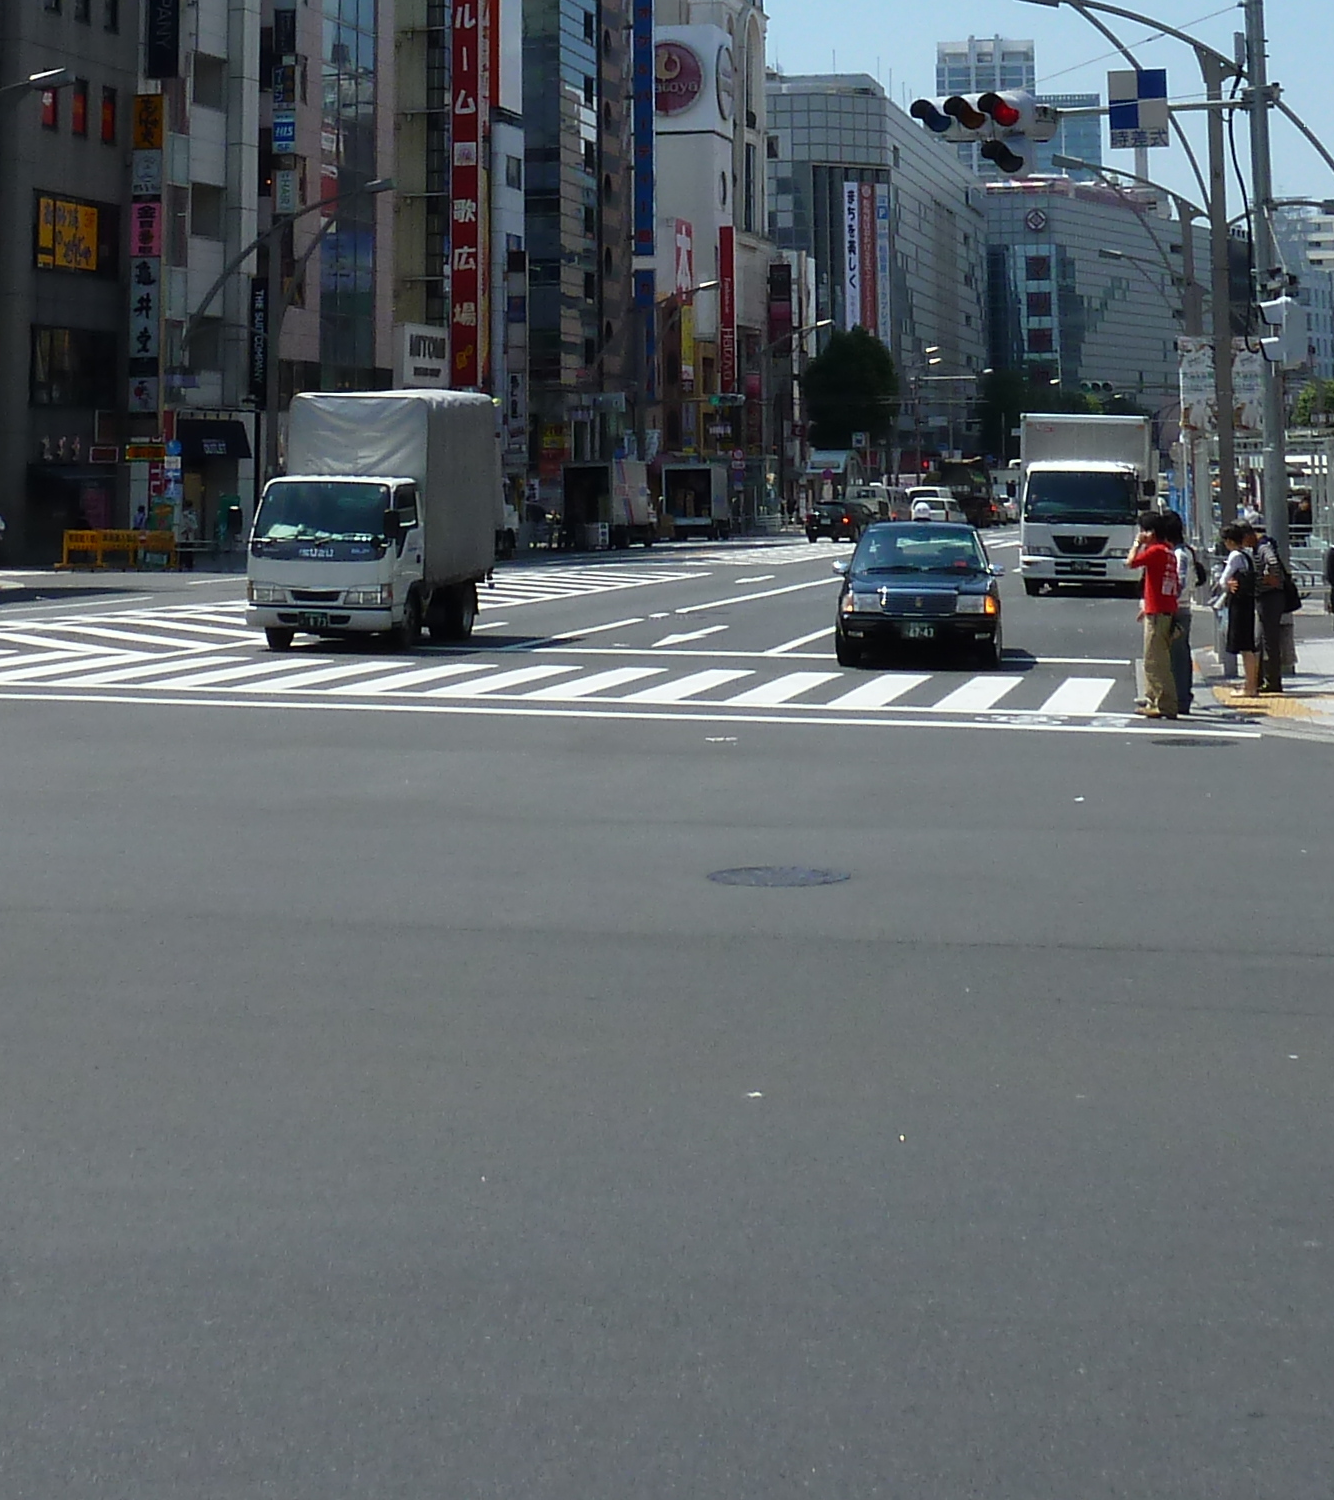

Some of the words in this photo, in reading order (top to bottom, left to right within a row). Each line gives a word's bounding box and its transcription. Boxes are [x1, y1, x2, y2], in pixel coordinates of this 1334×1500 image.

[654, 80, 699, 95] atoya
[1110, 128, 1169, 147] 時差式
[452, 199, 478, 328] 歌広場
[132, 259, 157, 354] 亀井堂
[254, 289, 265, 310] THE
[253, 334, 265, 384] COMPANY
